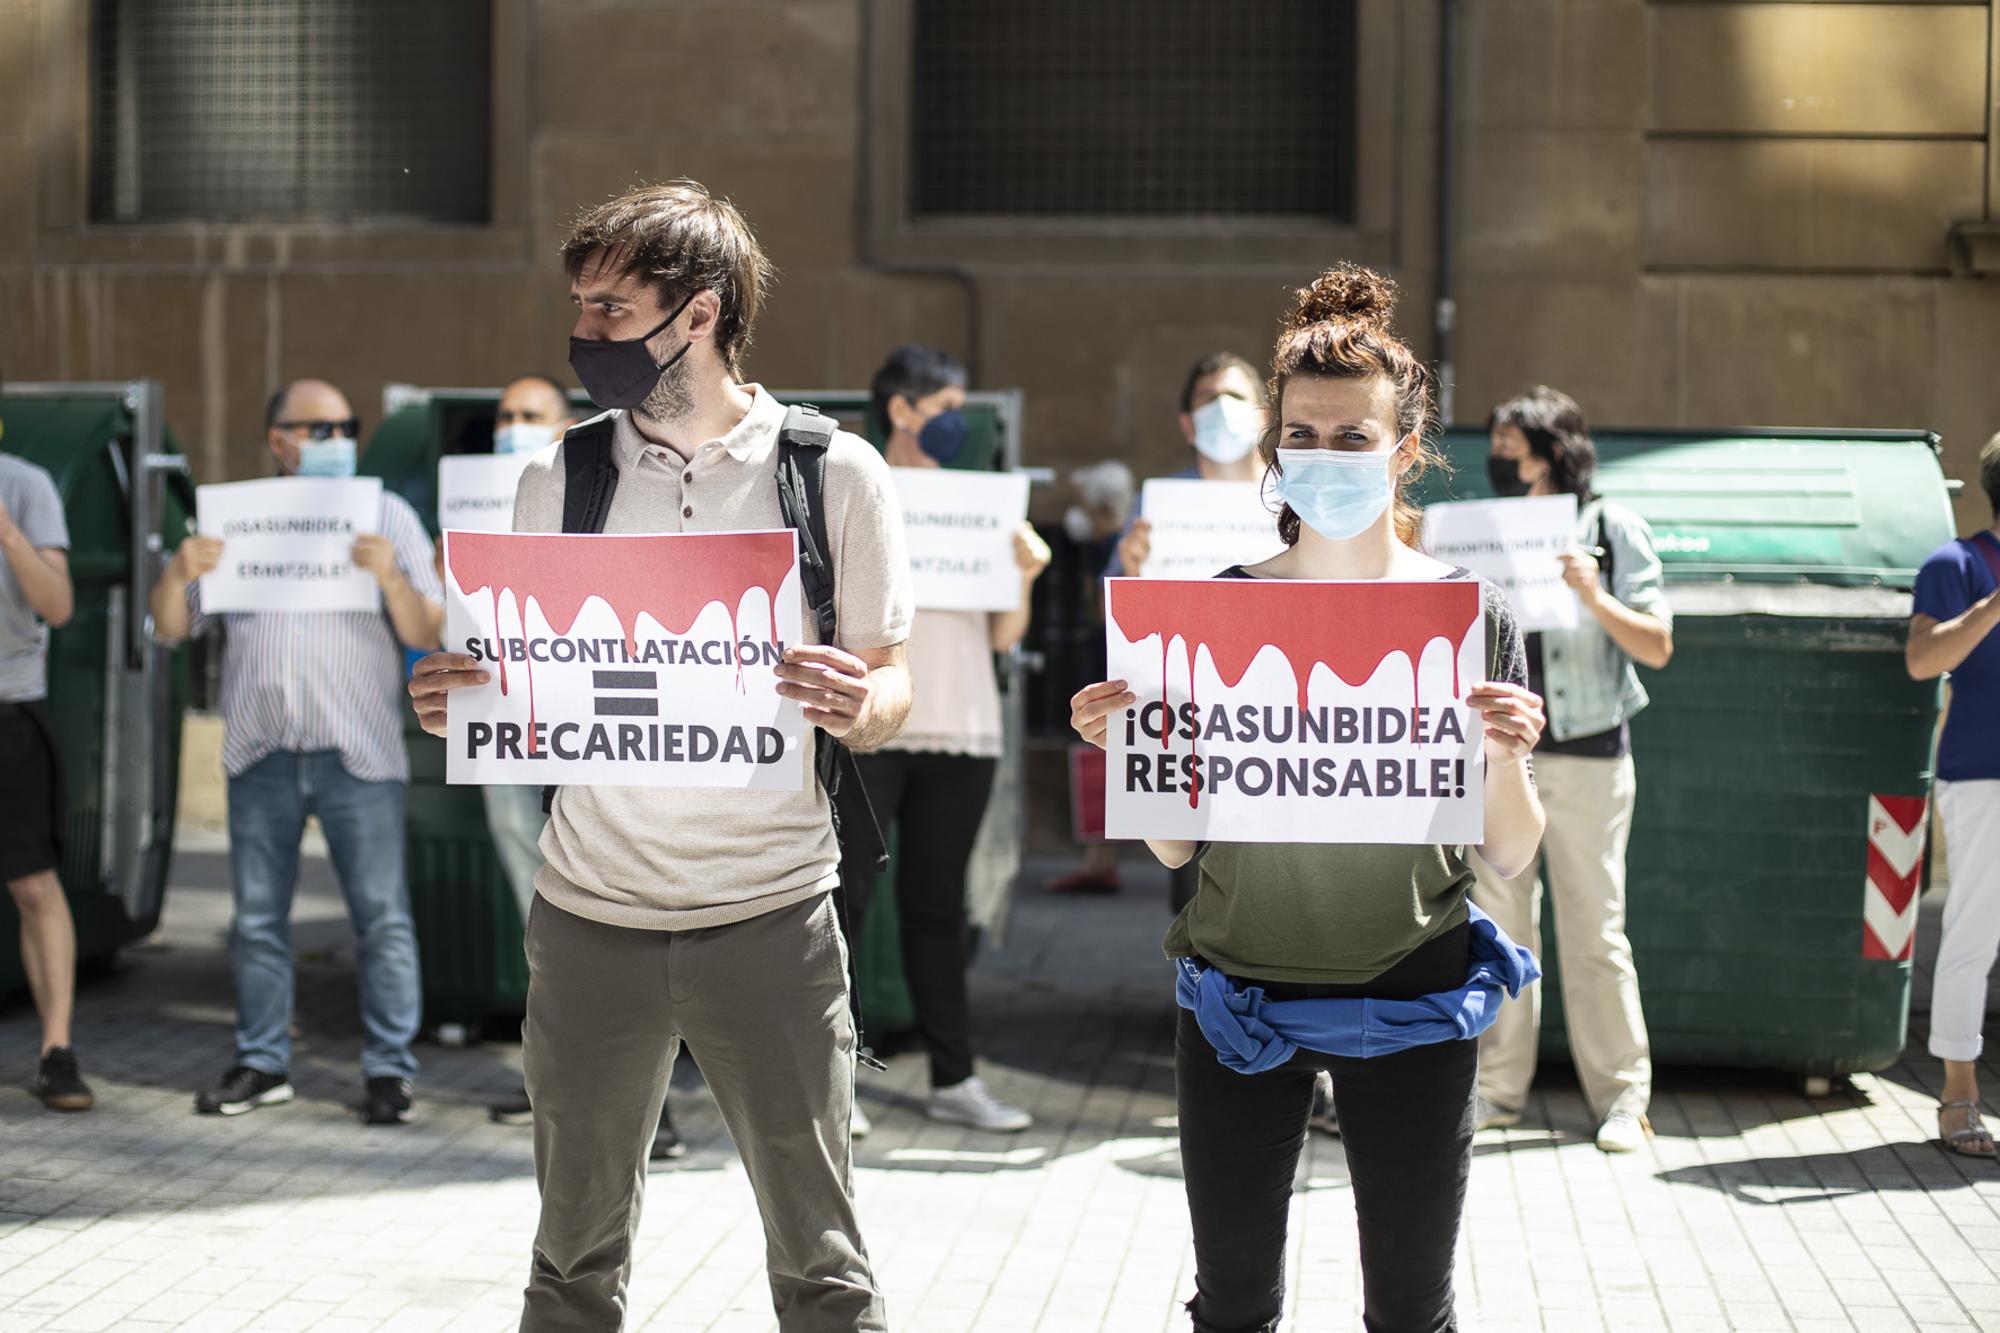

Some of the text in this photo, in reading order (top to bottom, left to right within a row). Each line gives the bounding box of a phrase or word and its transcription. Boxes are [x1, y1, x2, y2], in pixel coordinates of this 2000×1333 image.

[465, 634, 785, 666] SUBCONTRATACIÓN
[467, 721, 786, 765] PRECARIEDAD
[1125, 700, 1465, 746] ¡OSASUNBIDEA
[1125, 753, 1466, 799] RESPONSABLE!
